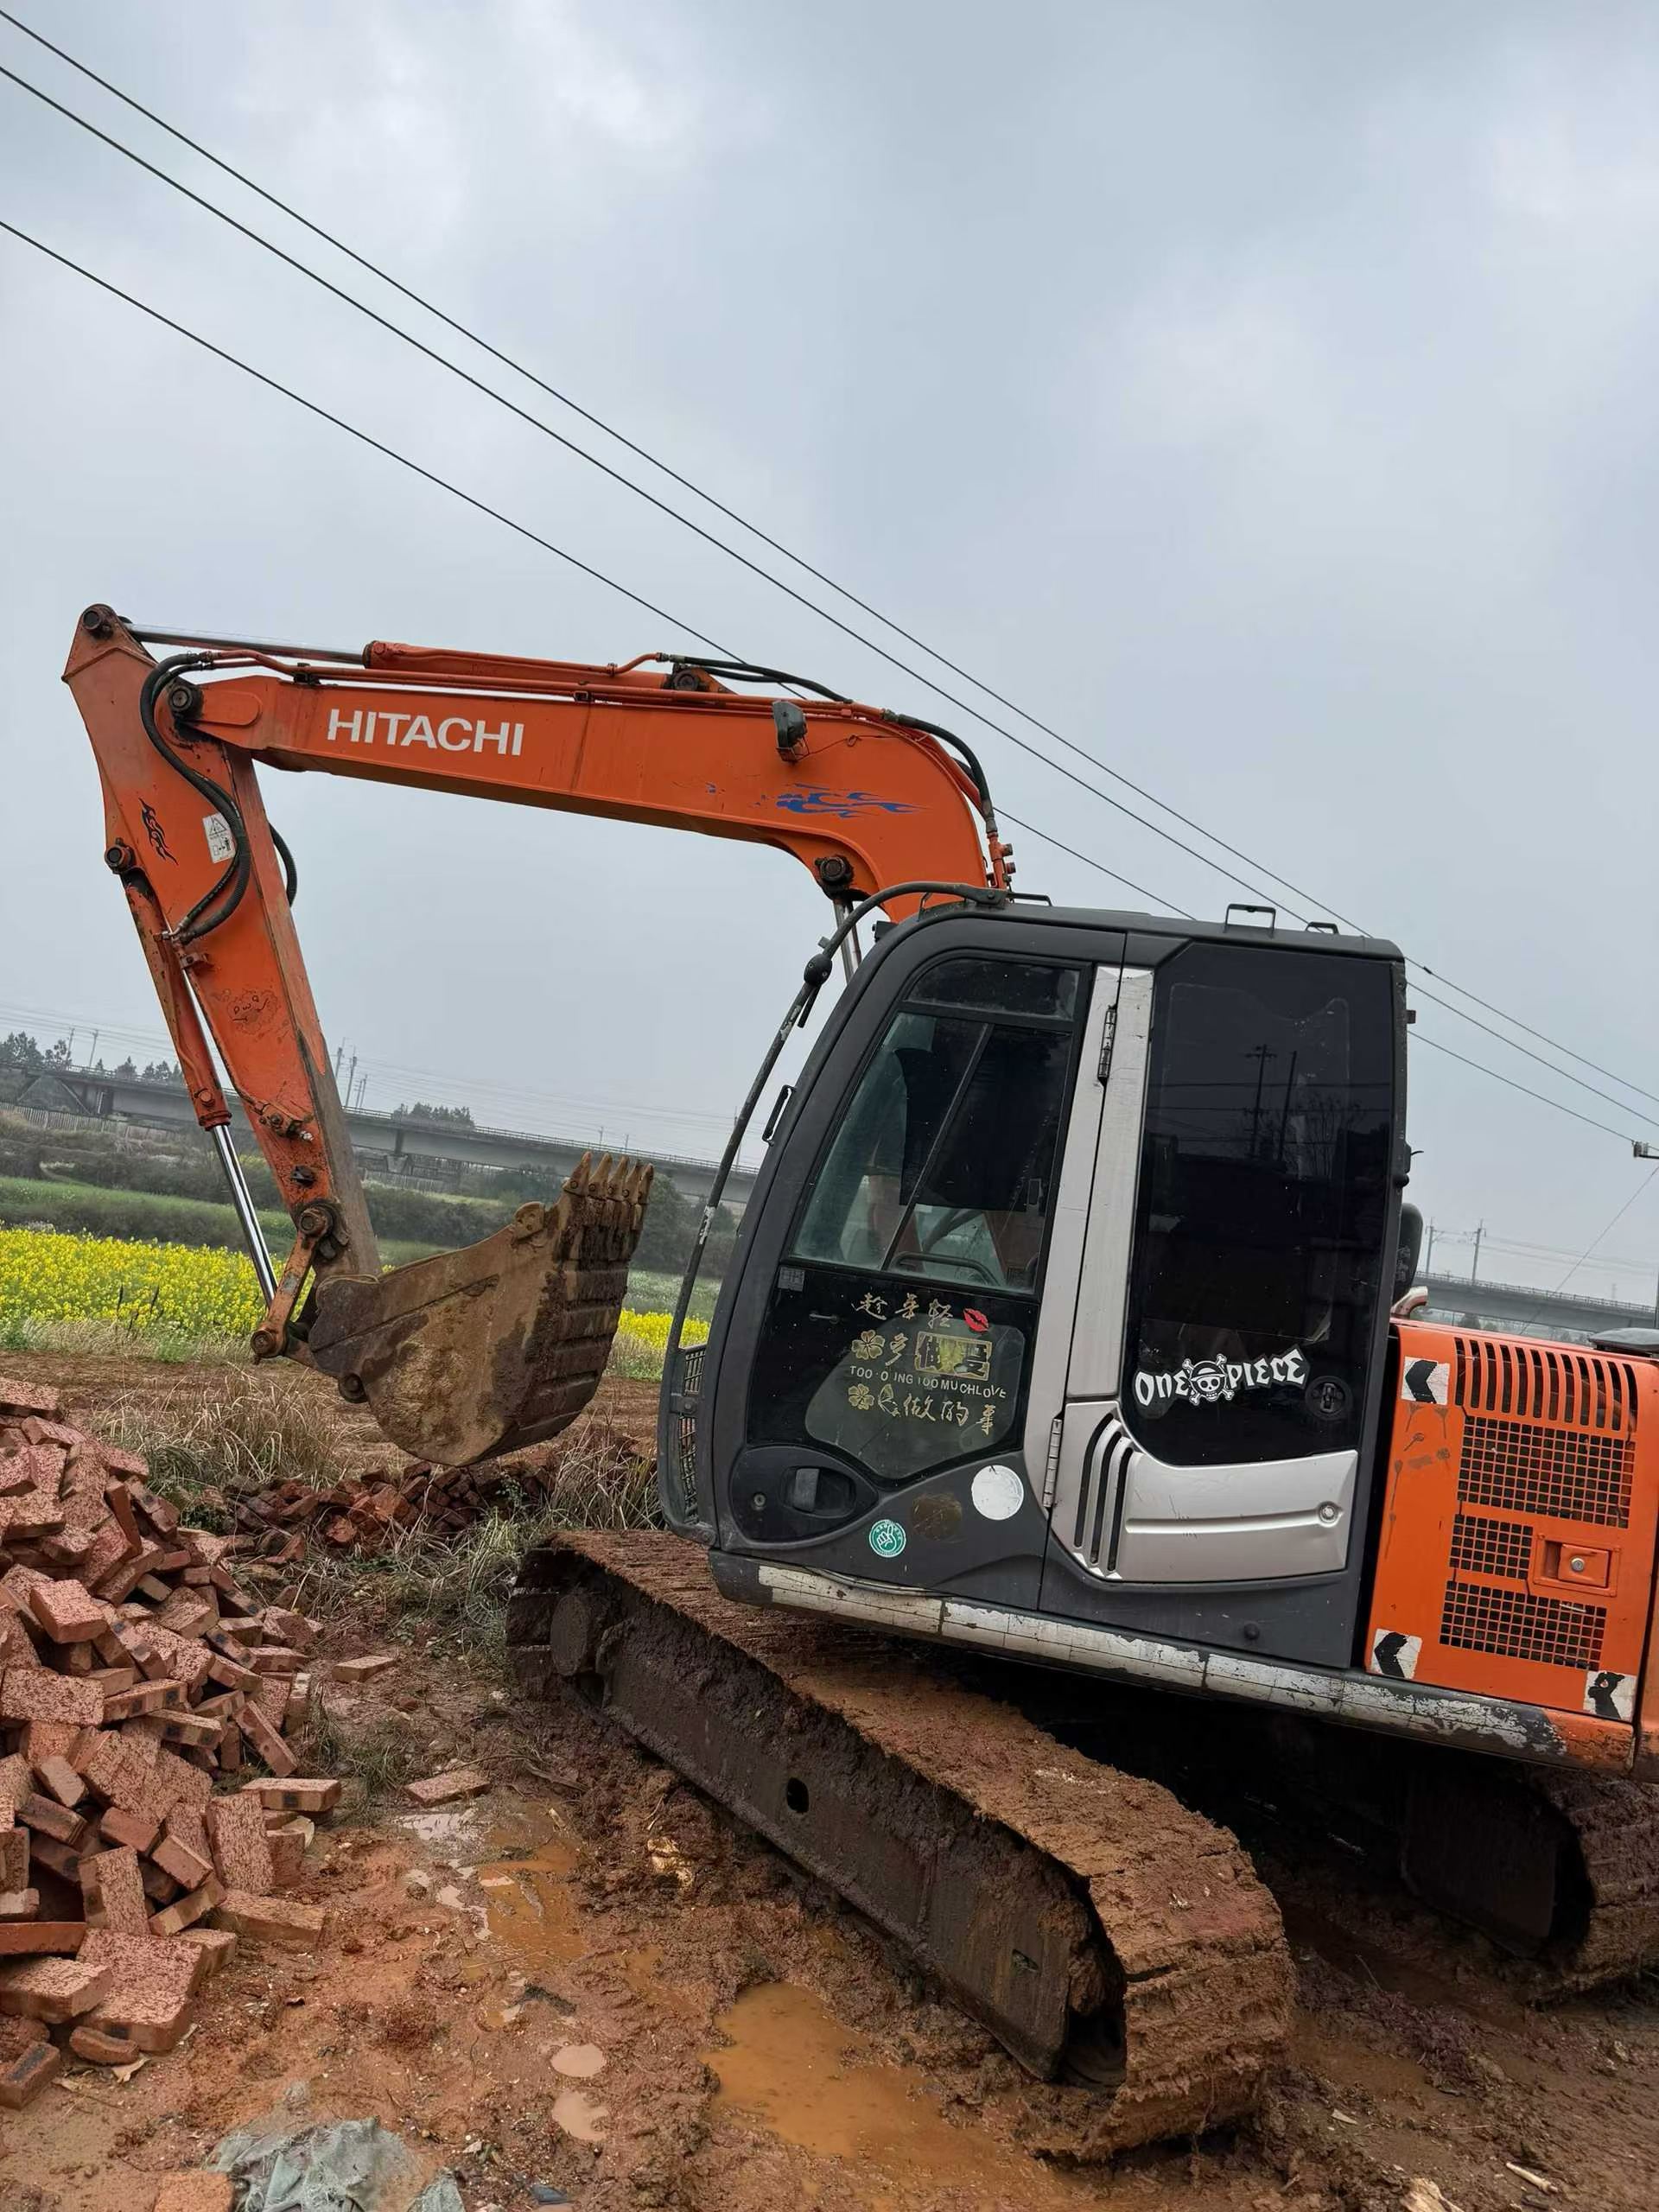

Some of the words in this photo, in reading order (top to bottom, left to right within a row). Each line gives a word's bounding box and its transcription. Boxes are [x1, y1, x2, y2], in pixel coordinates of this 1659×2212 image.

[327, 708, 524, 757] HITACHI
[849, 1364, 873, 1380] TOO
[1134, 1370, 1190, 1407] ONE
[1226, 1347, 1306, 1389] PIECE
